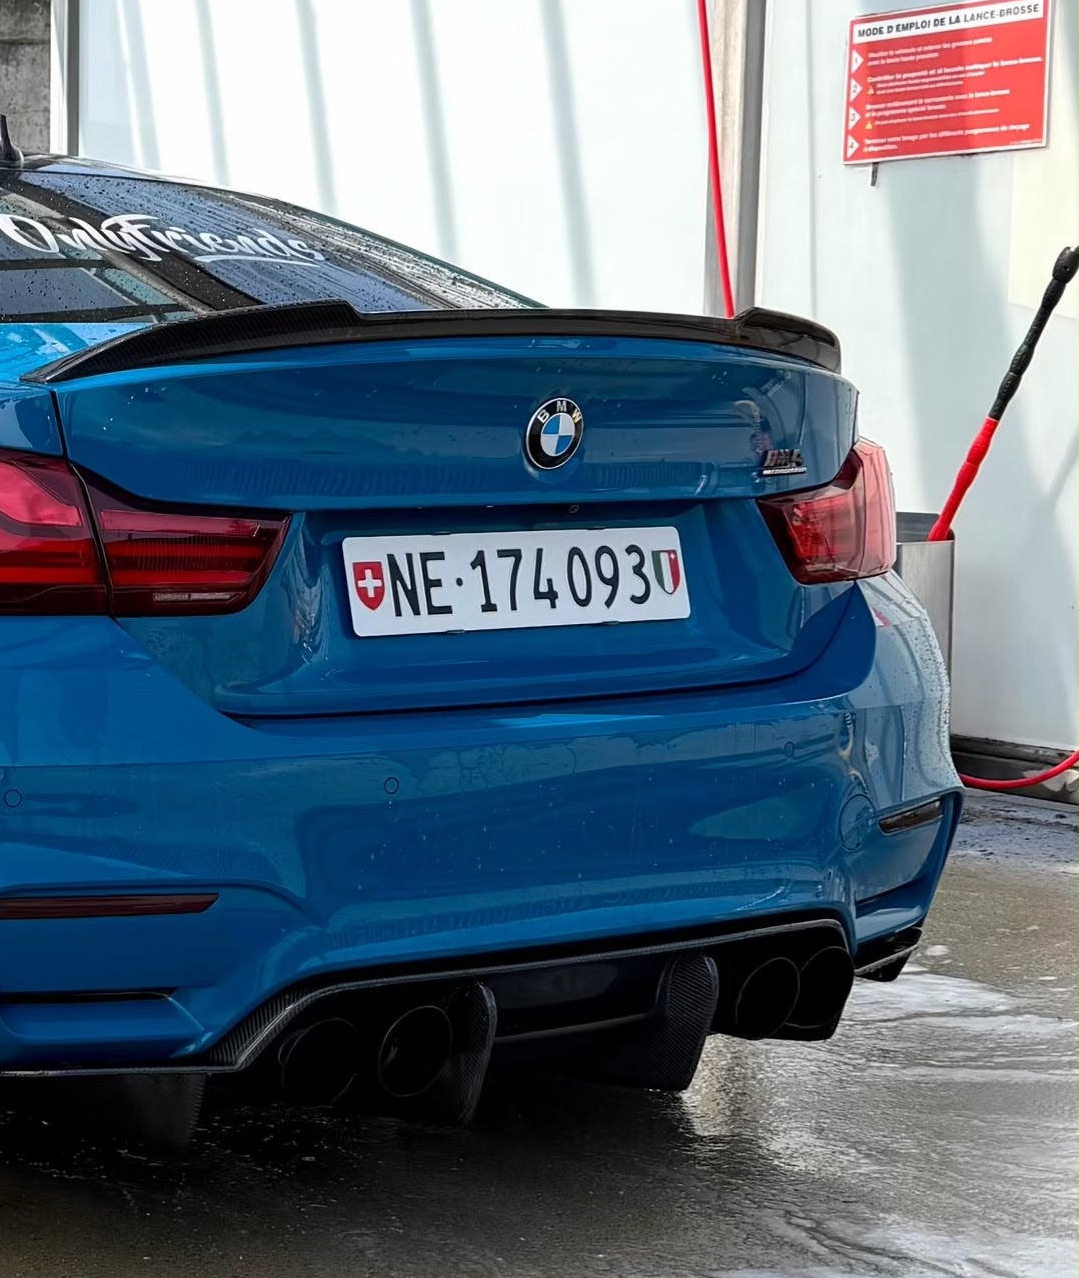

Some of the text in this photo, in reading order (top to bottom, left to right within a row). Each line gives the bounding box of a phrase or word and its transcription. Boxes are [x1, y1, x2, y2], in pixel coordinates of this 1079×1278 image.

[858, 26, 884, 38] MODE
[933, 17, 946, 27] DE
[948, 15, 961, 25] LA
[536, 400, 582, 423] BMW
